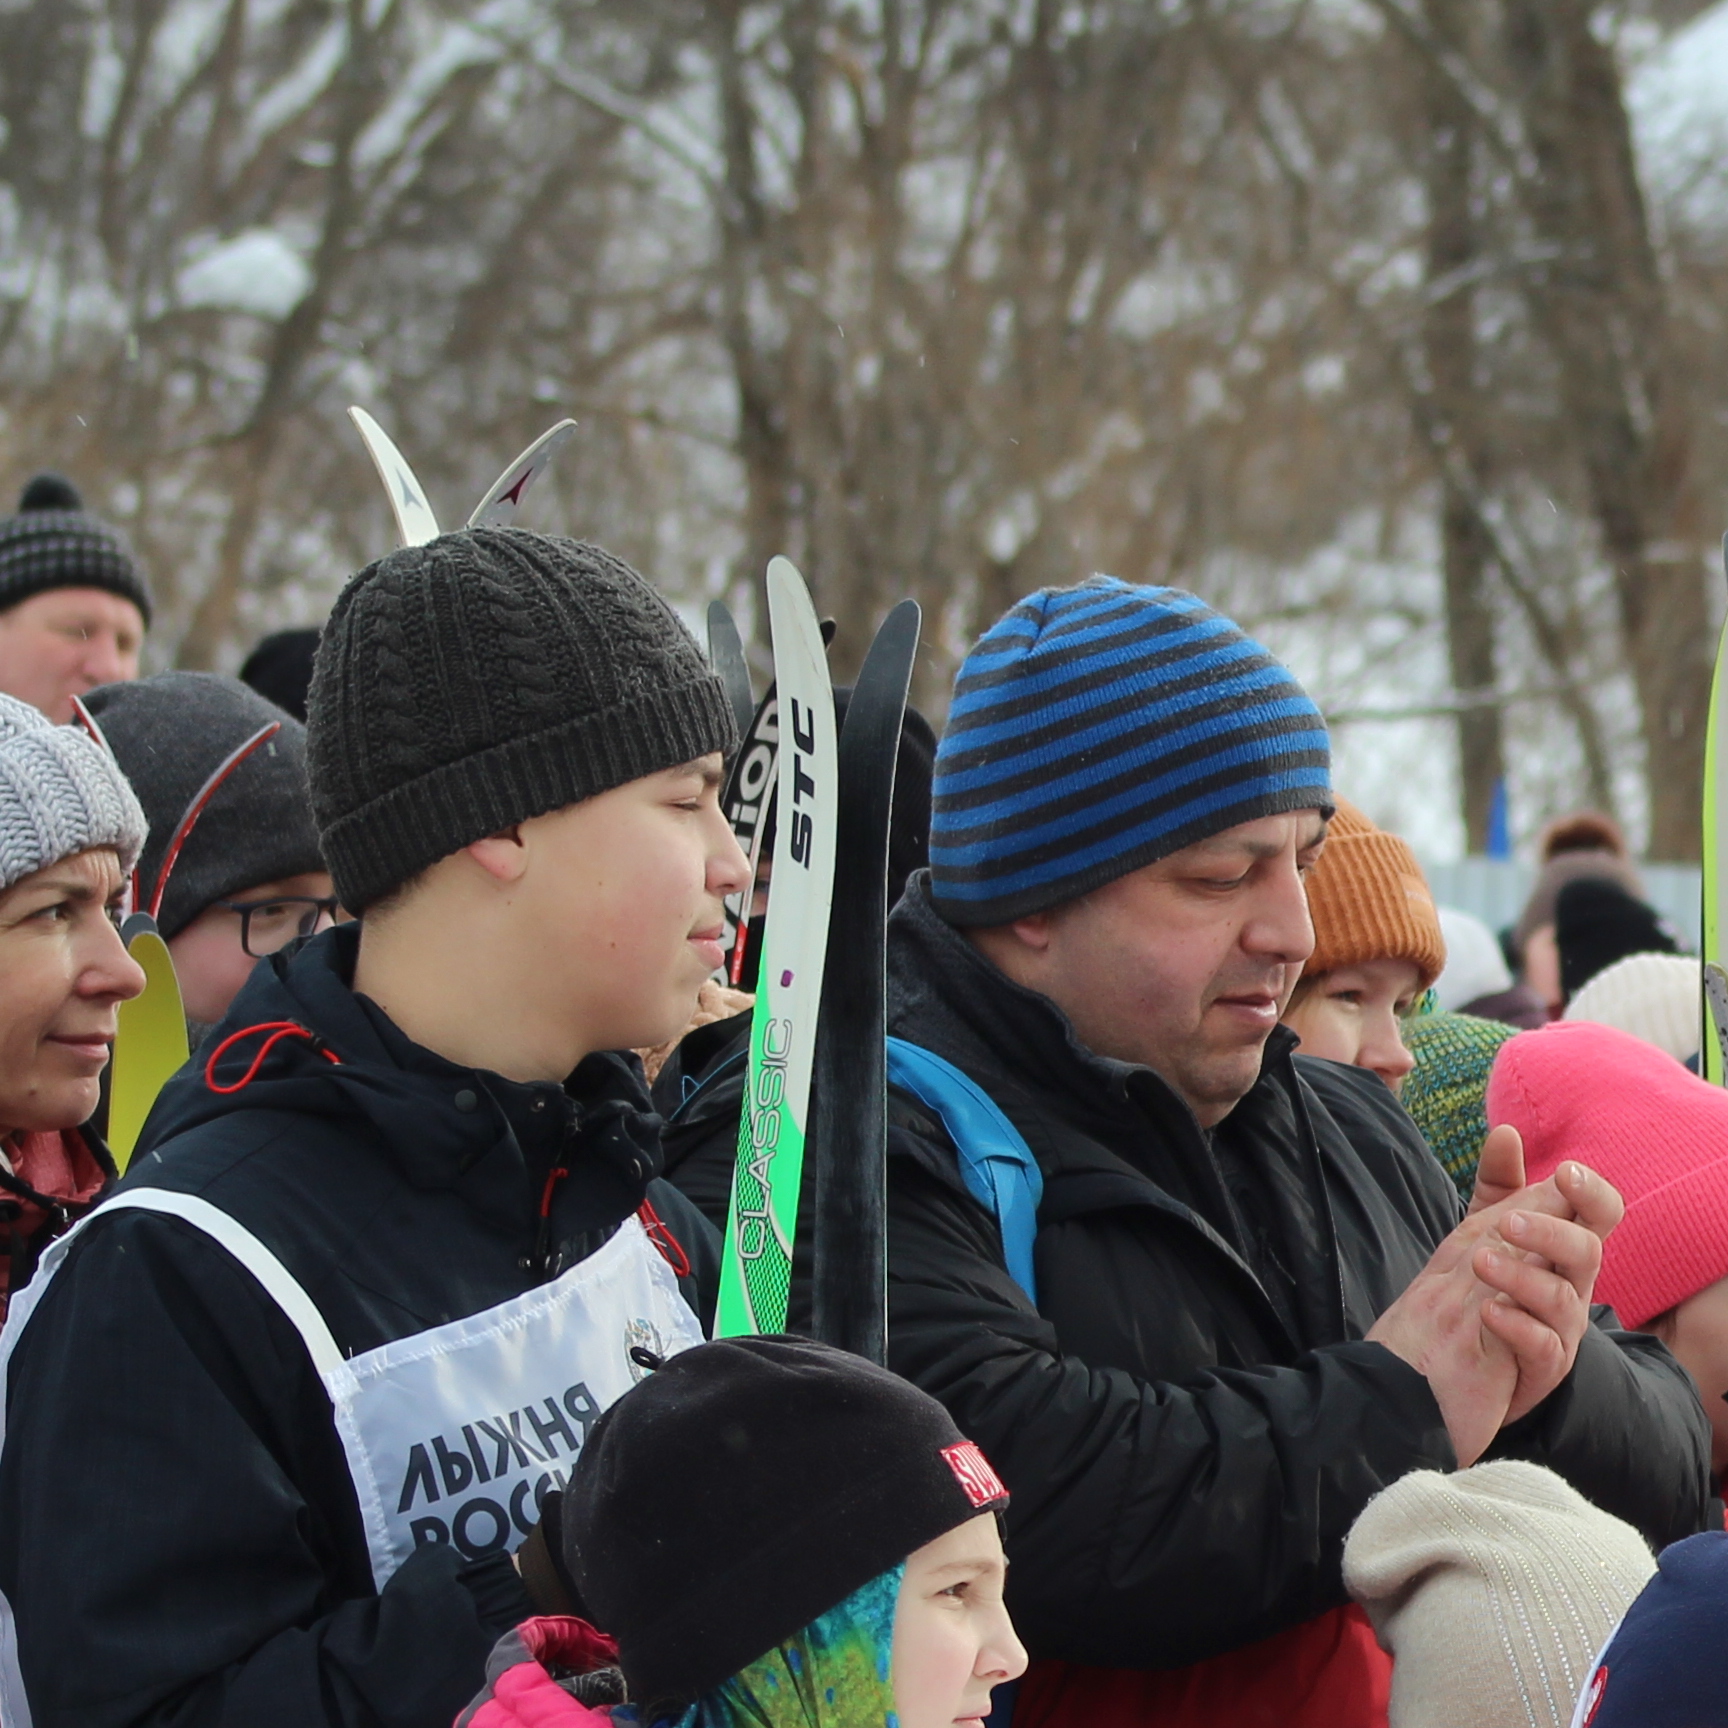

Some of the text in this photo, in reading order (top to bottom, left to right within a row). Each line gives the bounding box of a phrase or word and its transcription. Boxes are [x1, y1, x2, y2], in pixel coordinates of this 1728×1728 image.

[791, 697, 816, 871] STC
[736, 1017, 793, 1260] CLASSIC
[397, 1383, 602, 1515] ЛЫЖНЯ
[408, 1462, 580, 1562] РОСС
